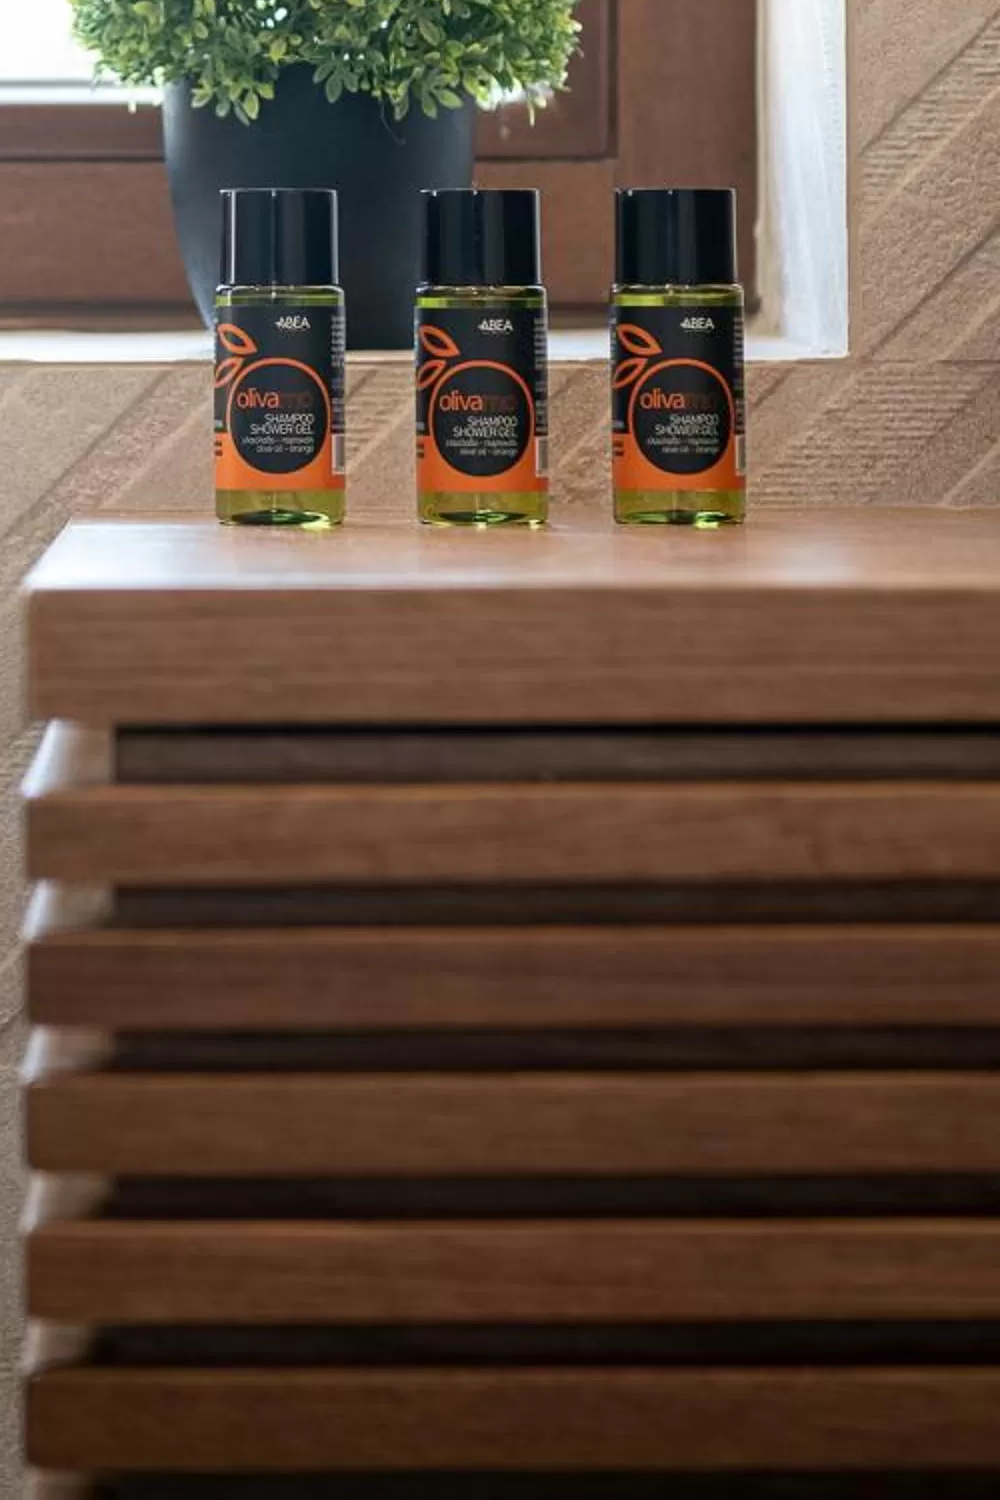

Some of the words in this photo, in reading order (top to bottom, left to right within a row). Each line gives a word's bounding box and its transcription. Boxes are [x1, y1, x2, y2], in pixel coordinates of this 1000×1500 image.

[478, 319, 513, 331] ABEA
[264, 413, 315, 424] SHAMPOO
[250, 424, 293, 435] SHOWER
[295, 424, 315, 435] GEL
